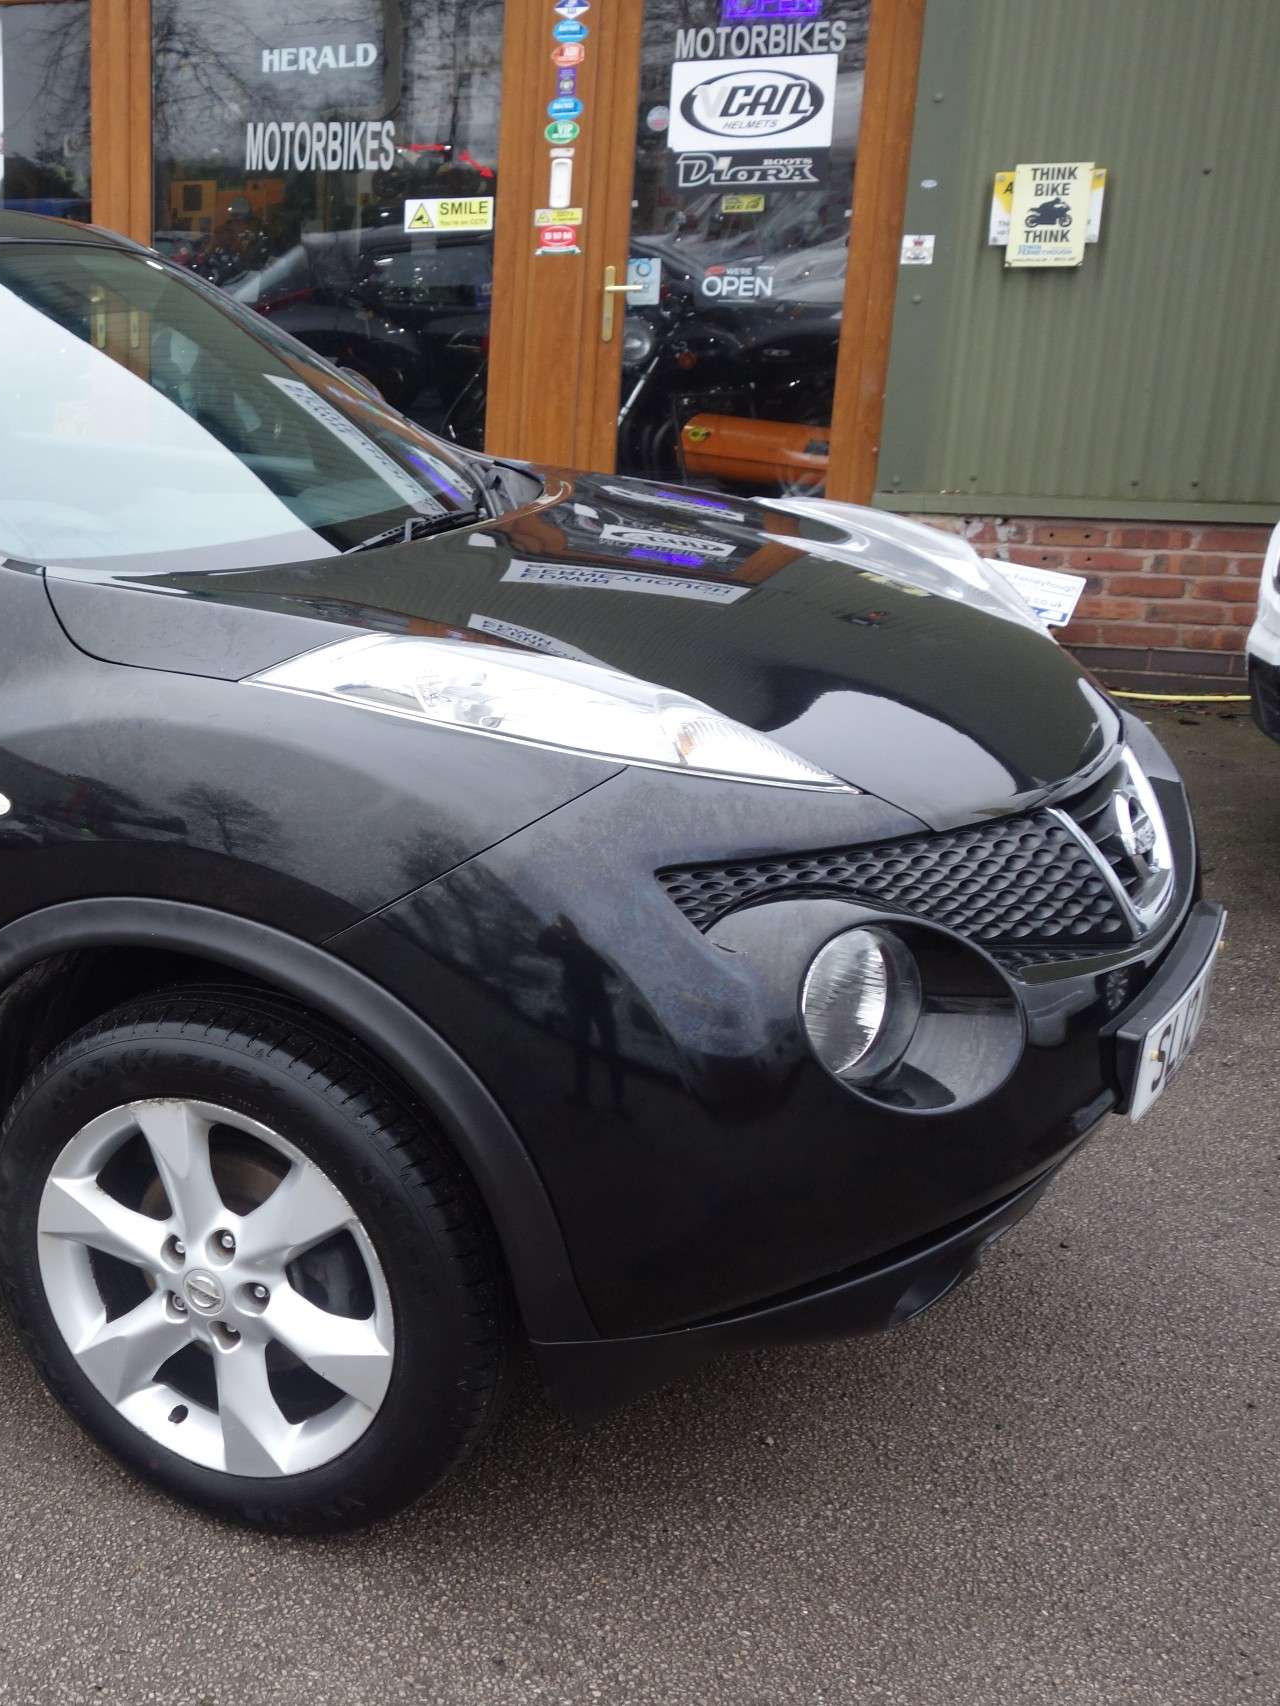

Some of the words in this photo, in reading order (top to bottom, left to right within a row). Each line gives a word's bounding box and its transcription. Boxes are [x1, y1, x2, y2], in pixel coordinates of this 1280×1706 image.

[675, 20, 847, 58] MOTORBIKES
[261, 43, 378, 74] HERALD
[722, 118, 777, 129] HELMETS
[245, 120, 395, 171] MOTORBIKES
[762, 157, 813, 165] BOOTS
[1031, 166, 1078, 181] THINK
[1034, 182, 1071, 197] BIKE
[439, 200, 489, 215] SMILE
[1023, 229, 1071, 244] THINK
[701, 275, 775, 297] OPEN
